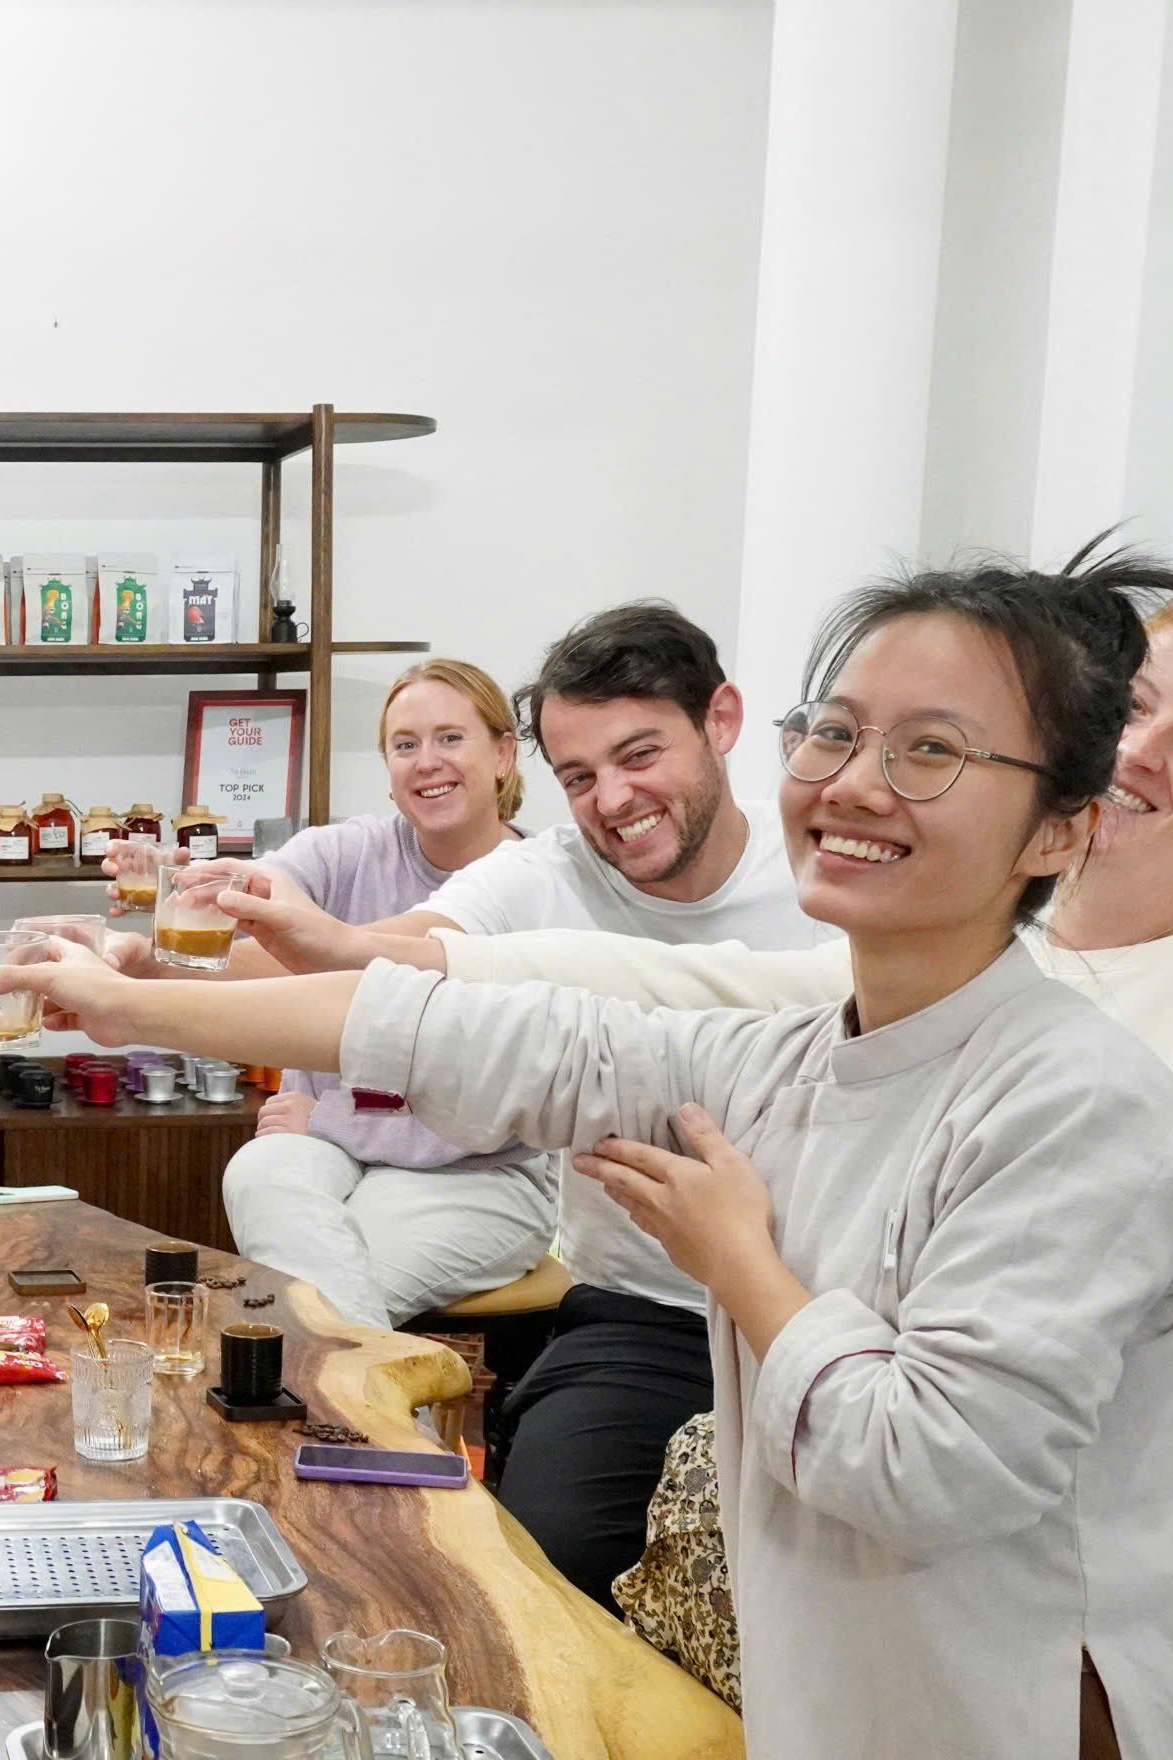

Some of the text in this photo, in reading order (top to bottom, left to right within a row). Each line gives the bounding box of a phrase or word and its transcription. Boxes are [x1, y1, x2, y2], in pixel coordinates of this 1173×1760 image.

[229, 718, 251, 727] GET
[229, 728, 261, 736] YOUR
[228, 736, 263, 746] GUIDE
[219, 783, 265, 792] TOP PICK
